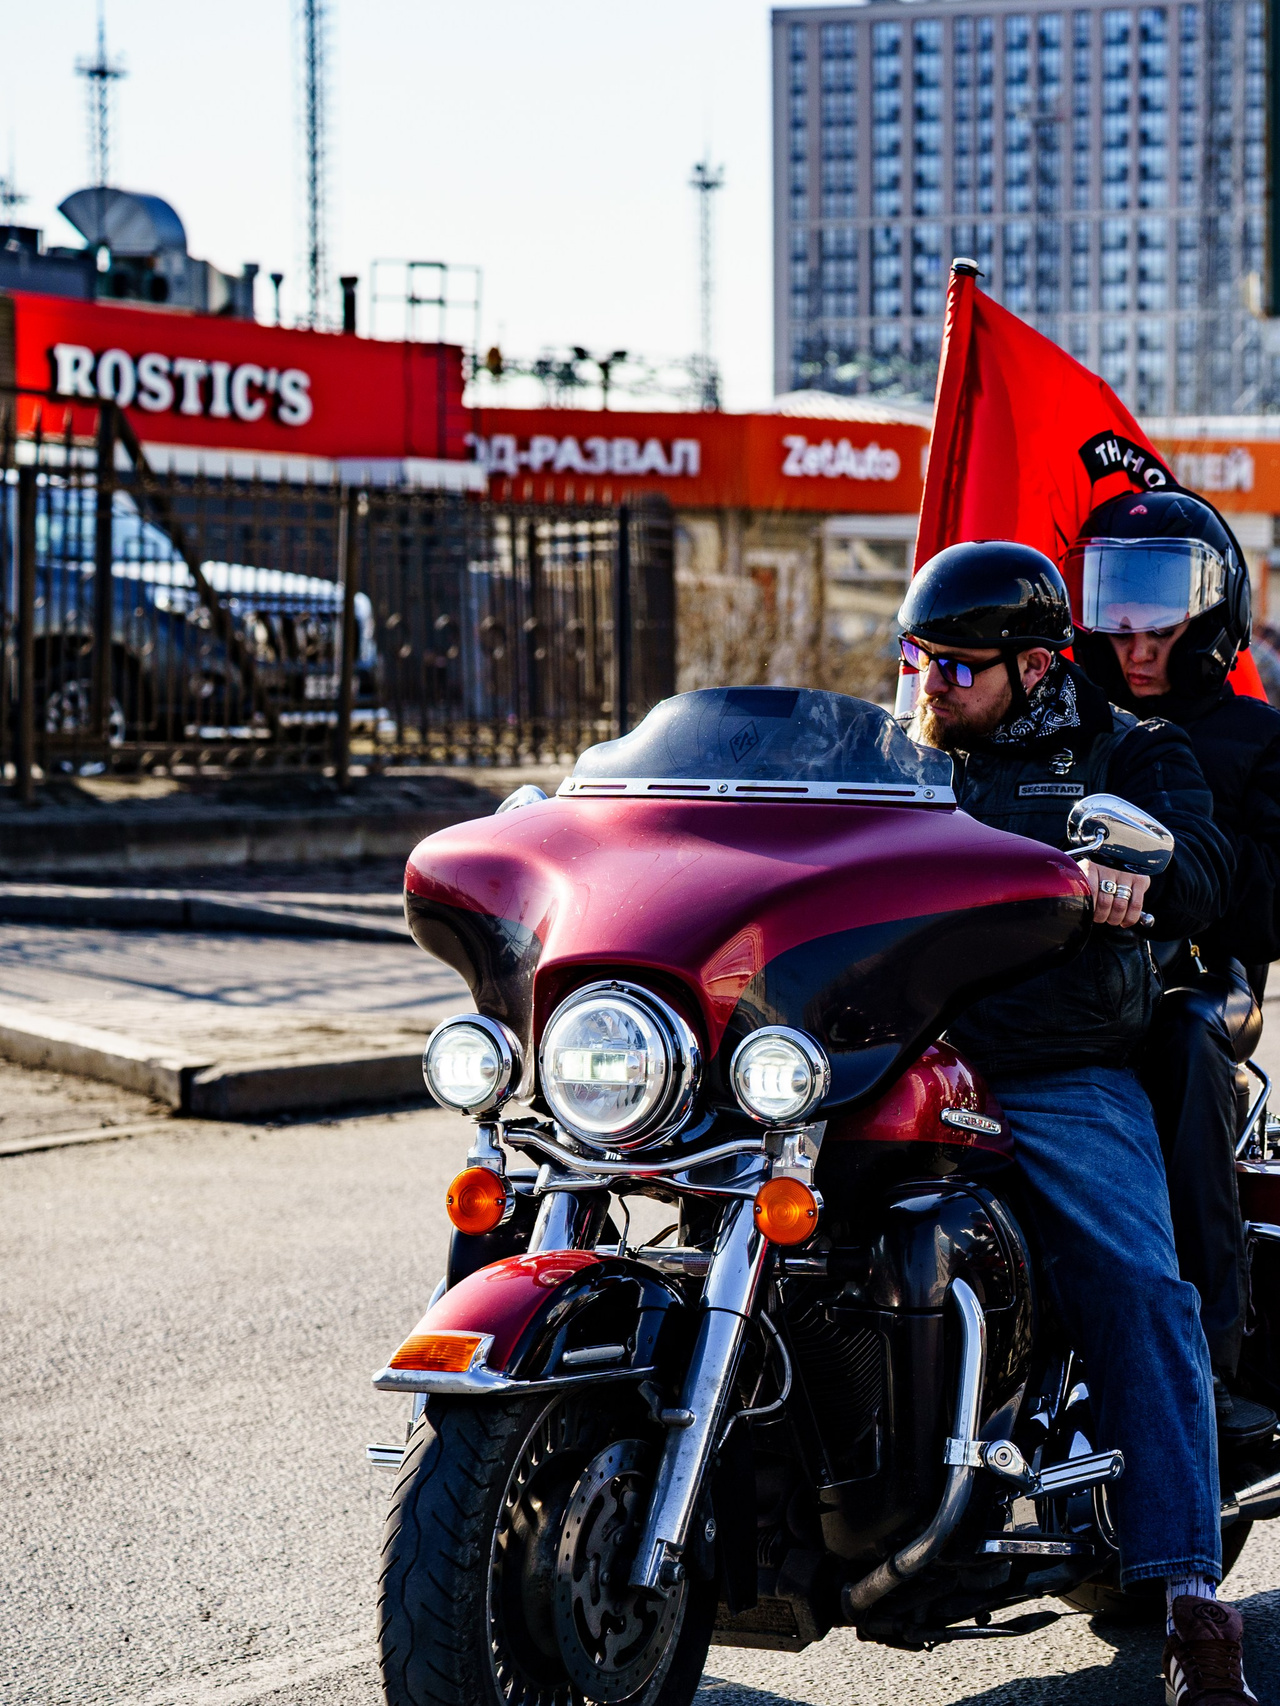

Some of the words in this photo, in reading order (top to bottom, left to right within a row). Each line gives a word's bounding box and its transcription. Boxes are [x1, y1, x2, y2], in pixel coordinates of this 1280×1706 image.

[54, 342, 314, 427] ROSTIC'S
[782, 434, 901, 482] ZetAuto
[1021, 784, 1082, 794] SECRETARY
